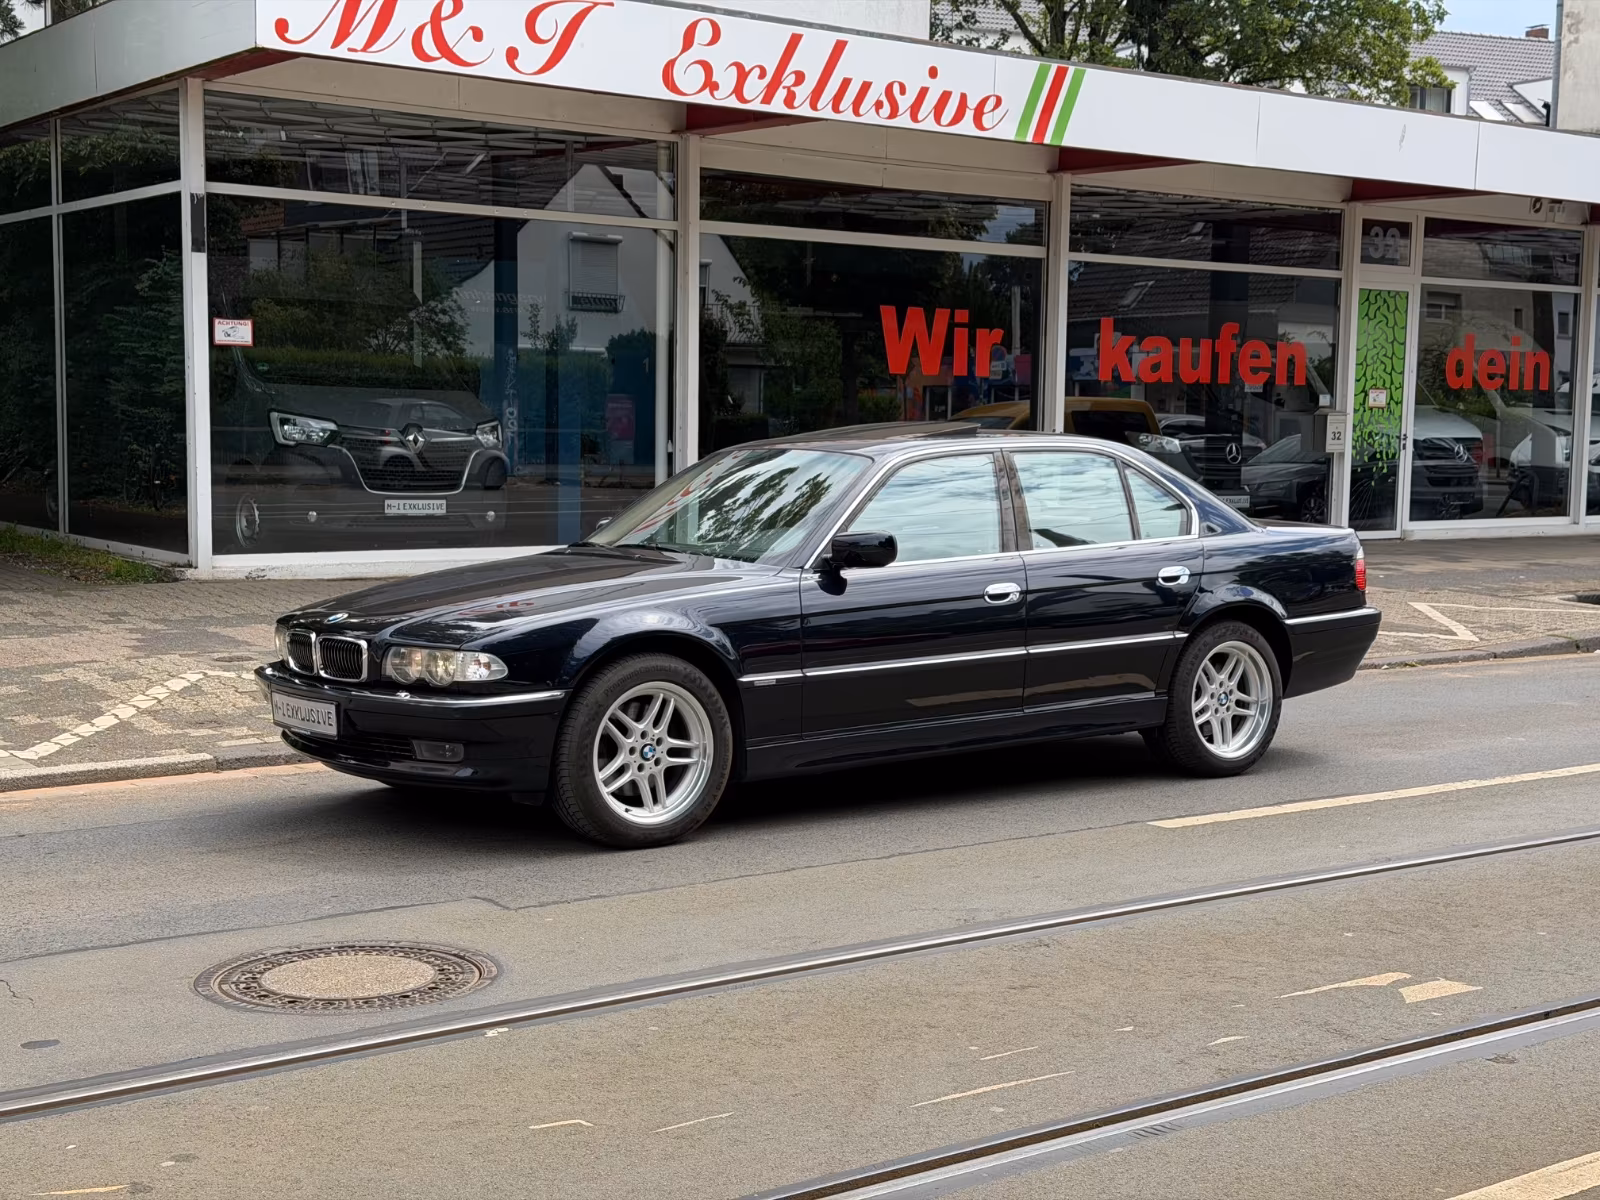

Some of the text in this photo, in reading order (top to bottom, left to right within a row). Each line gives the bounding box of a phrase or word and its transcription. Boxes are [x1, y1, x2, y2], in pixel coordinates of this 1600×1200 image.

[662, 17, 1008, 132] Exklusive
[1369, 226, 1400, 258] 32
[880, 305, 1551, 391] Wir kaufen dein
[1331, 431, 1342, 441] 32
[402, 502, 445, 511] EXKLUSIVE
[286, 702, 334, 727] EXKLUSIVE
